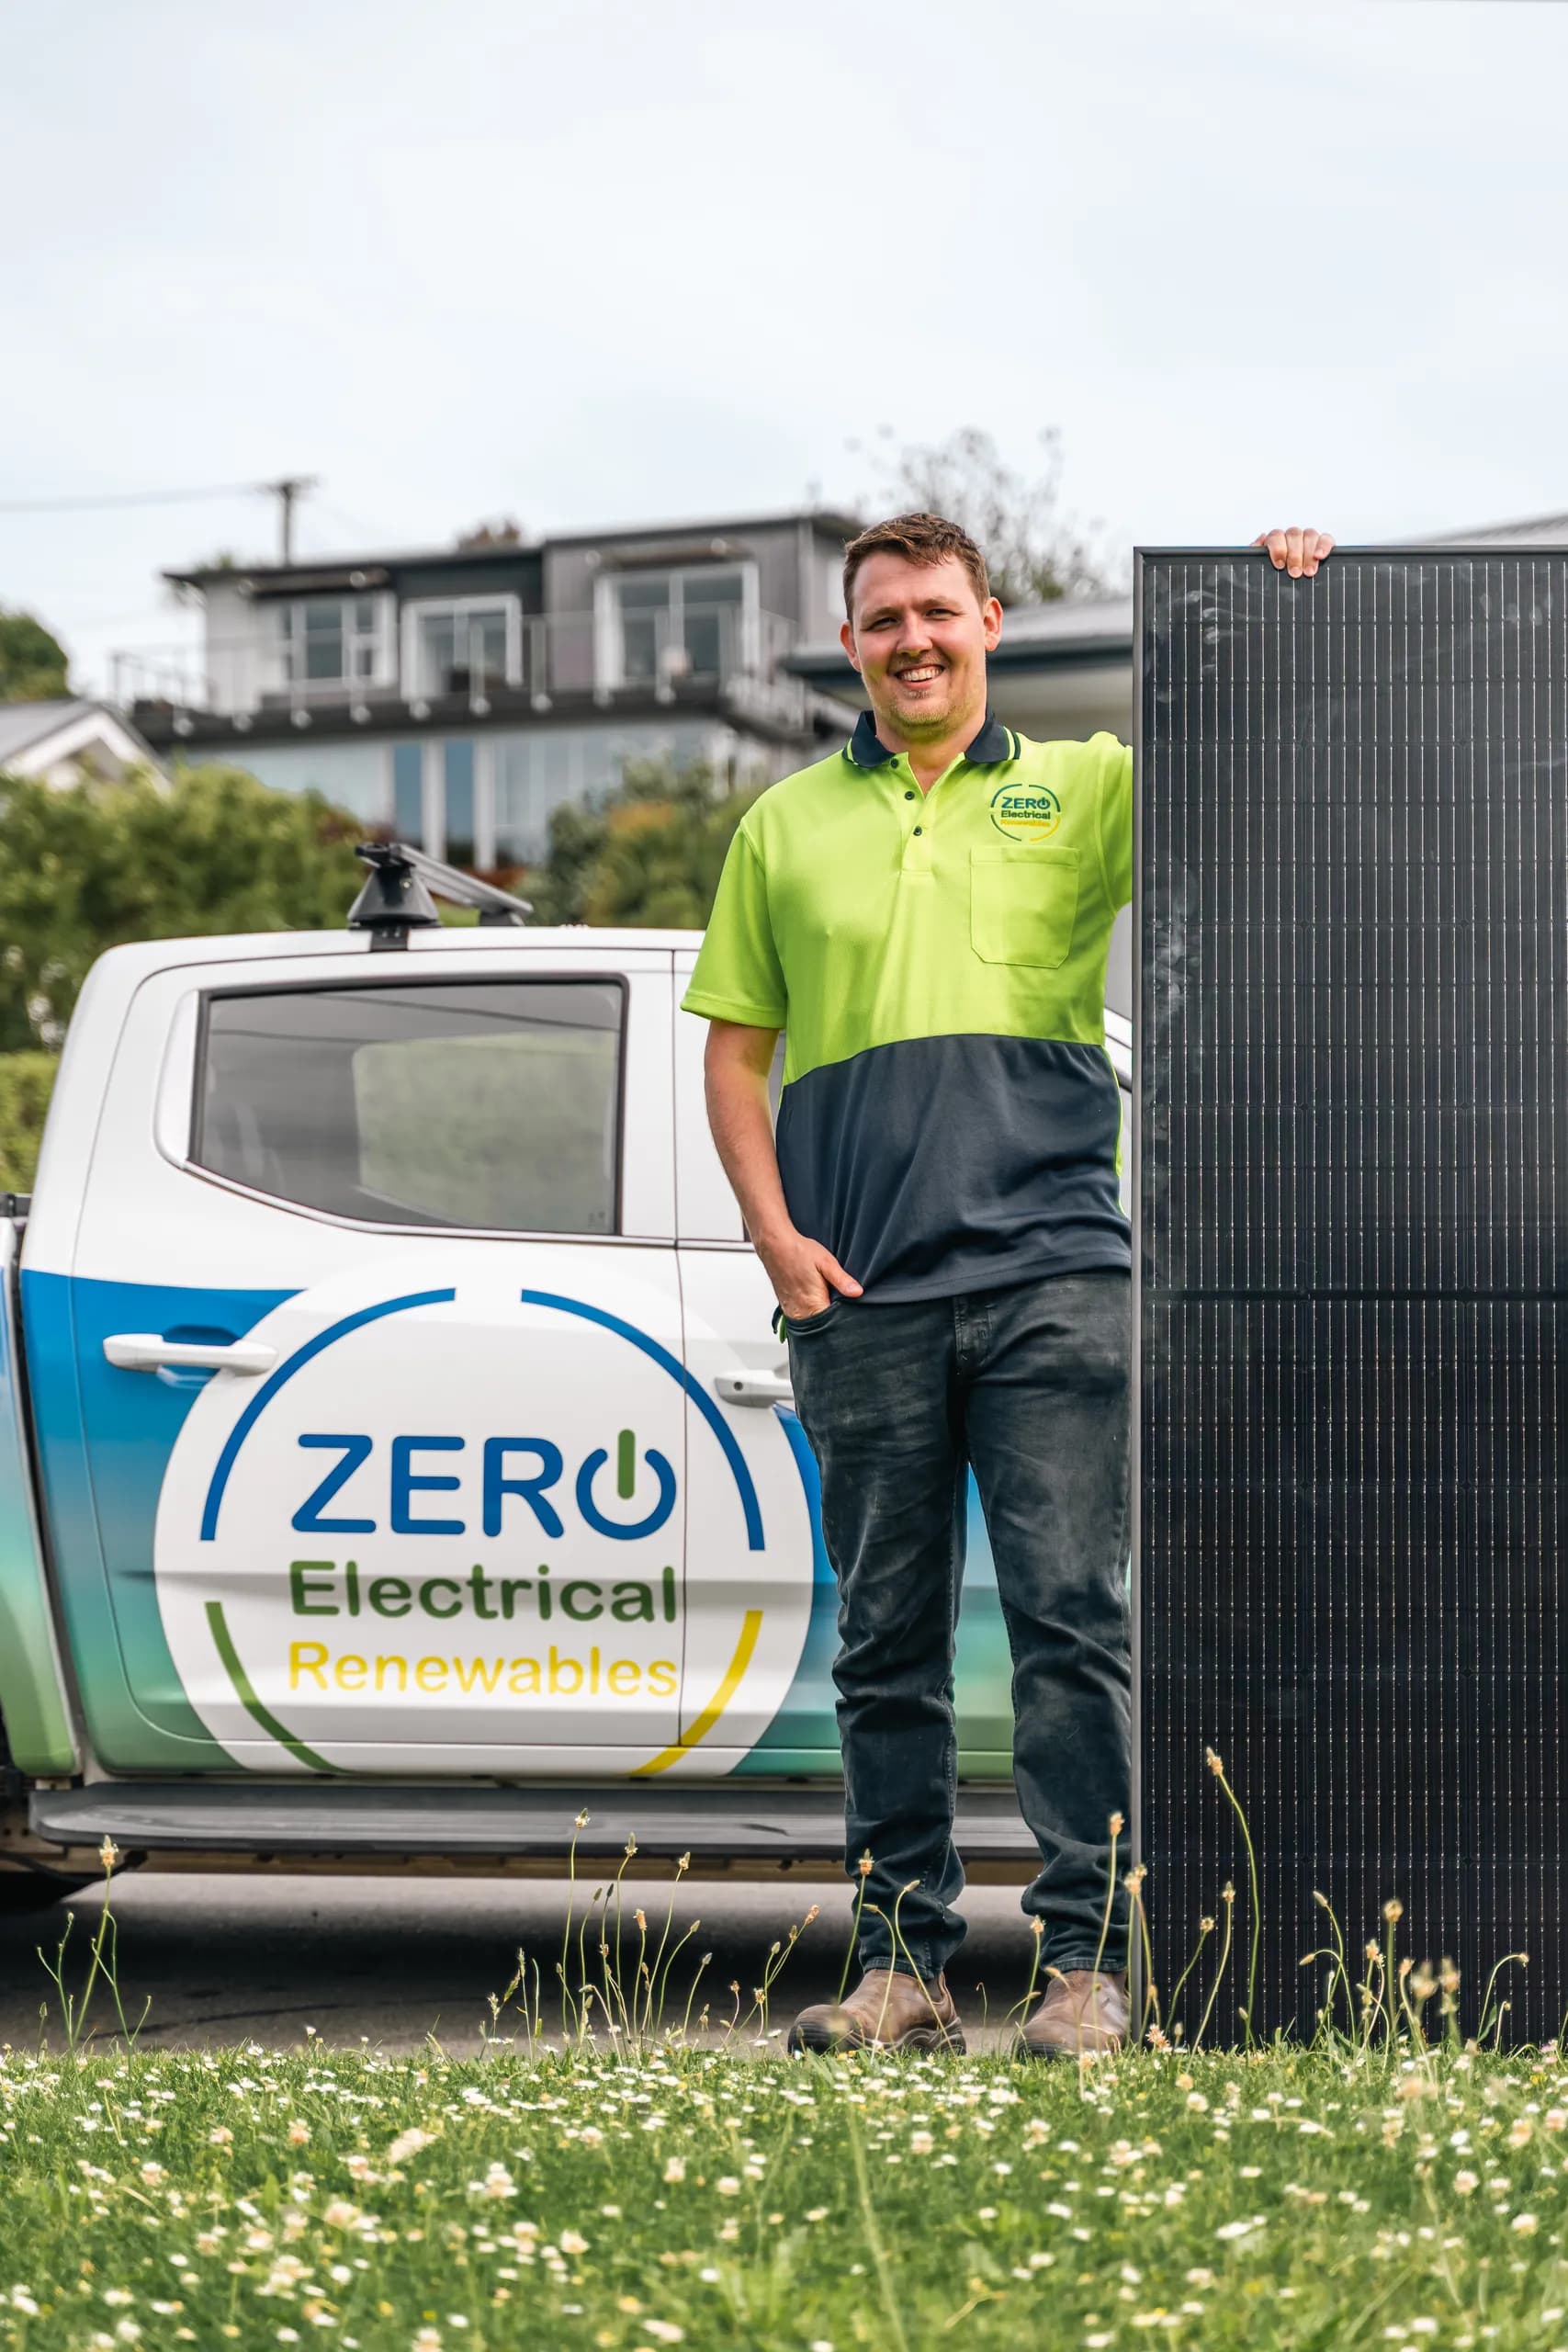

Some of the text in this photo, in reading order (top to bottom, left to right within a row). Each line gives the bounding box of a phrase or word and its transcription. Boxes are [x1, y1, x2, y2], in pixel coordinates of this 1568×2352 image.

[1000, 809, 1051, 820] Electrical
[1001, 797, 1051, 809] ZERO
[291, 1429, 677, 1541] ZERO
[289, 1560, 676, 1623] Electrical
[288, 1641, 678, 1697] Renewables
